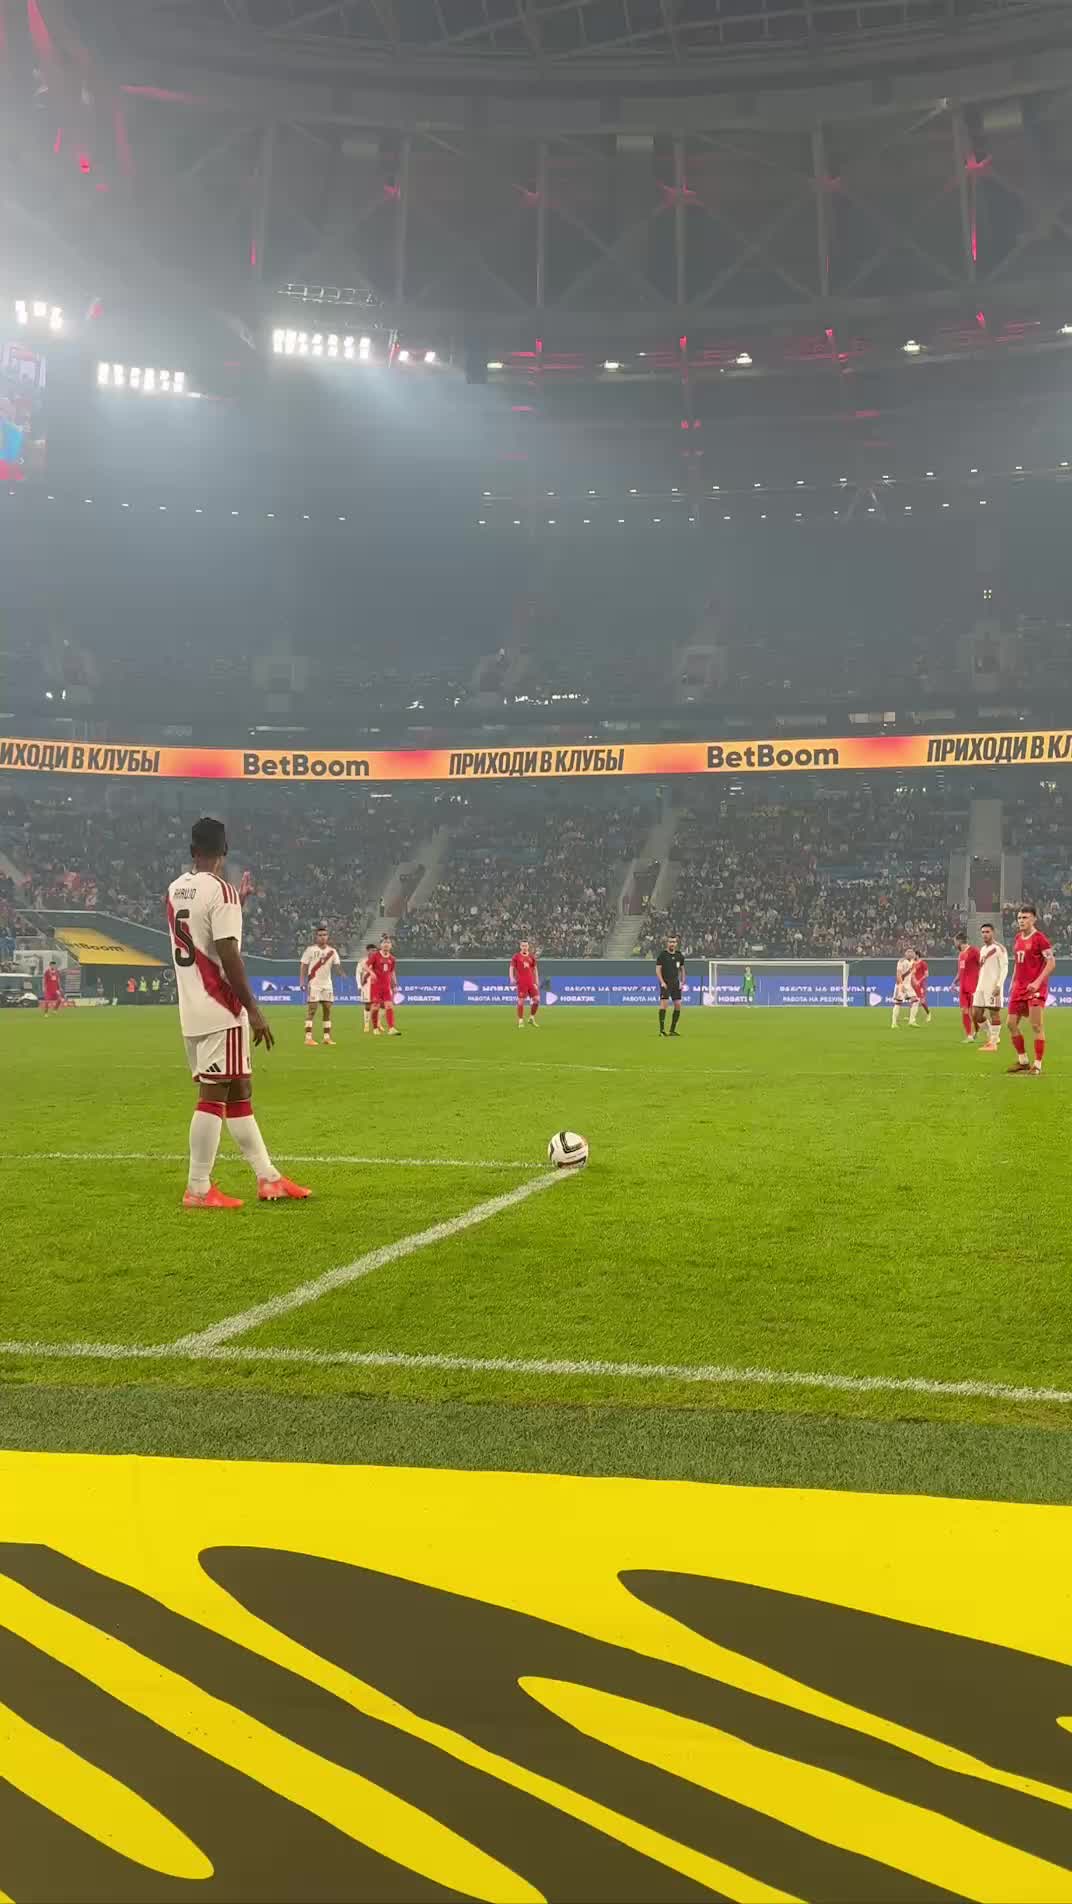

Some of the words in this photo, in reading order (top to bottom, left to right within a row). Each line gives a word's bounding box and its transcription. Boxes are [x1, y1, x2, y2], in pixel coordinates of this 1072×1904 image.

[71, 747, 84, 769] В
[87, 748, 160, 773] КЛУБЫ
[449, 751, 537, 776] ПРИХОДИ
[539, 751, 552, 773] В
[555, 748, 624, 772] КЛУБЫ
[707, 744, 839, 768] BetBoom
[927, 736, 1027, 763] ПРИХОДИ
[1030, 736, 1044, 759] В
[243, 753, 370, 777] BetBoom
[175, 909, 196, 967] 5
[1017, 950, 1026, 963] 17
